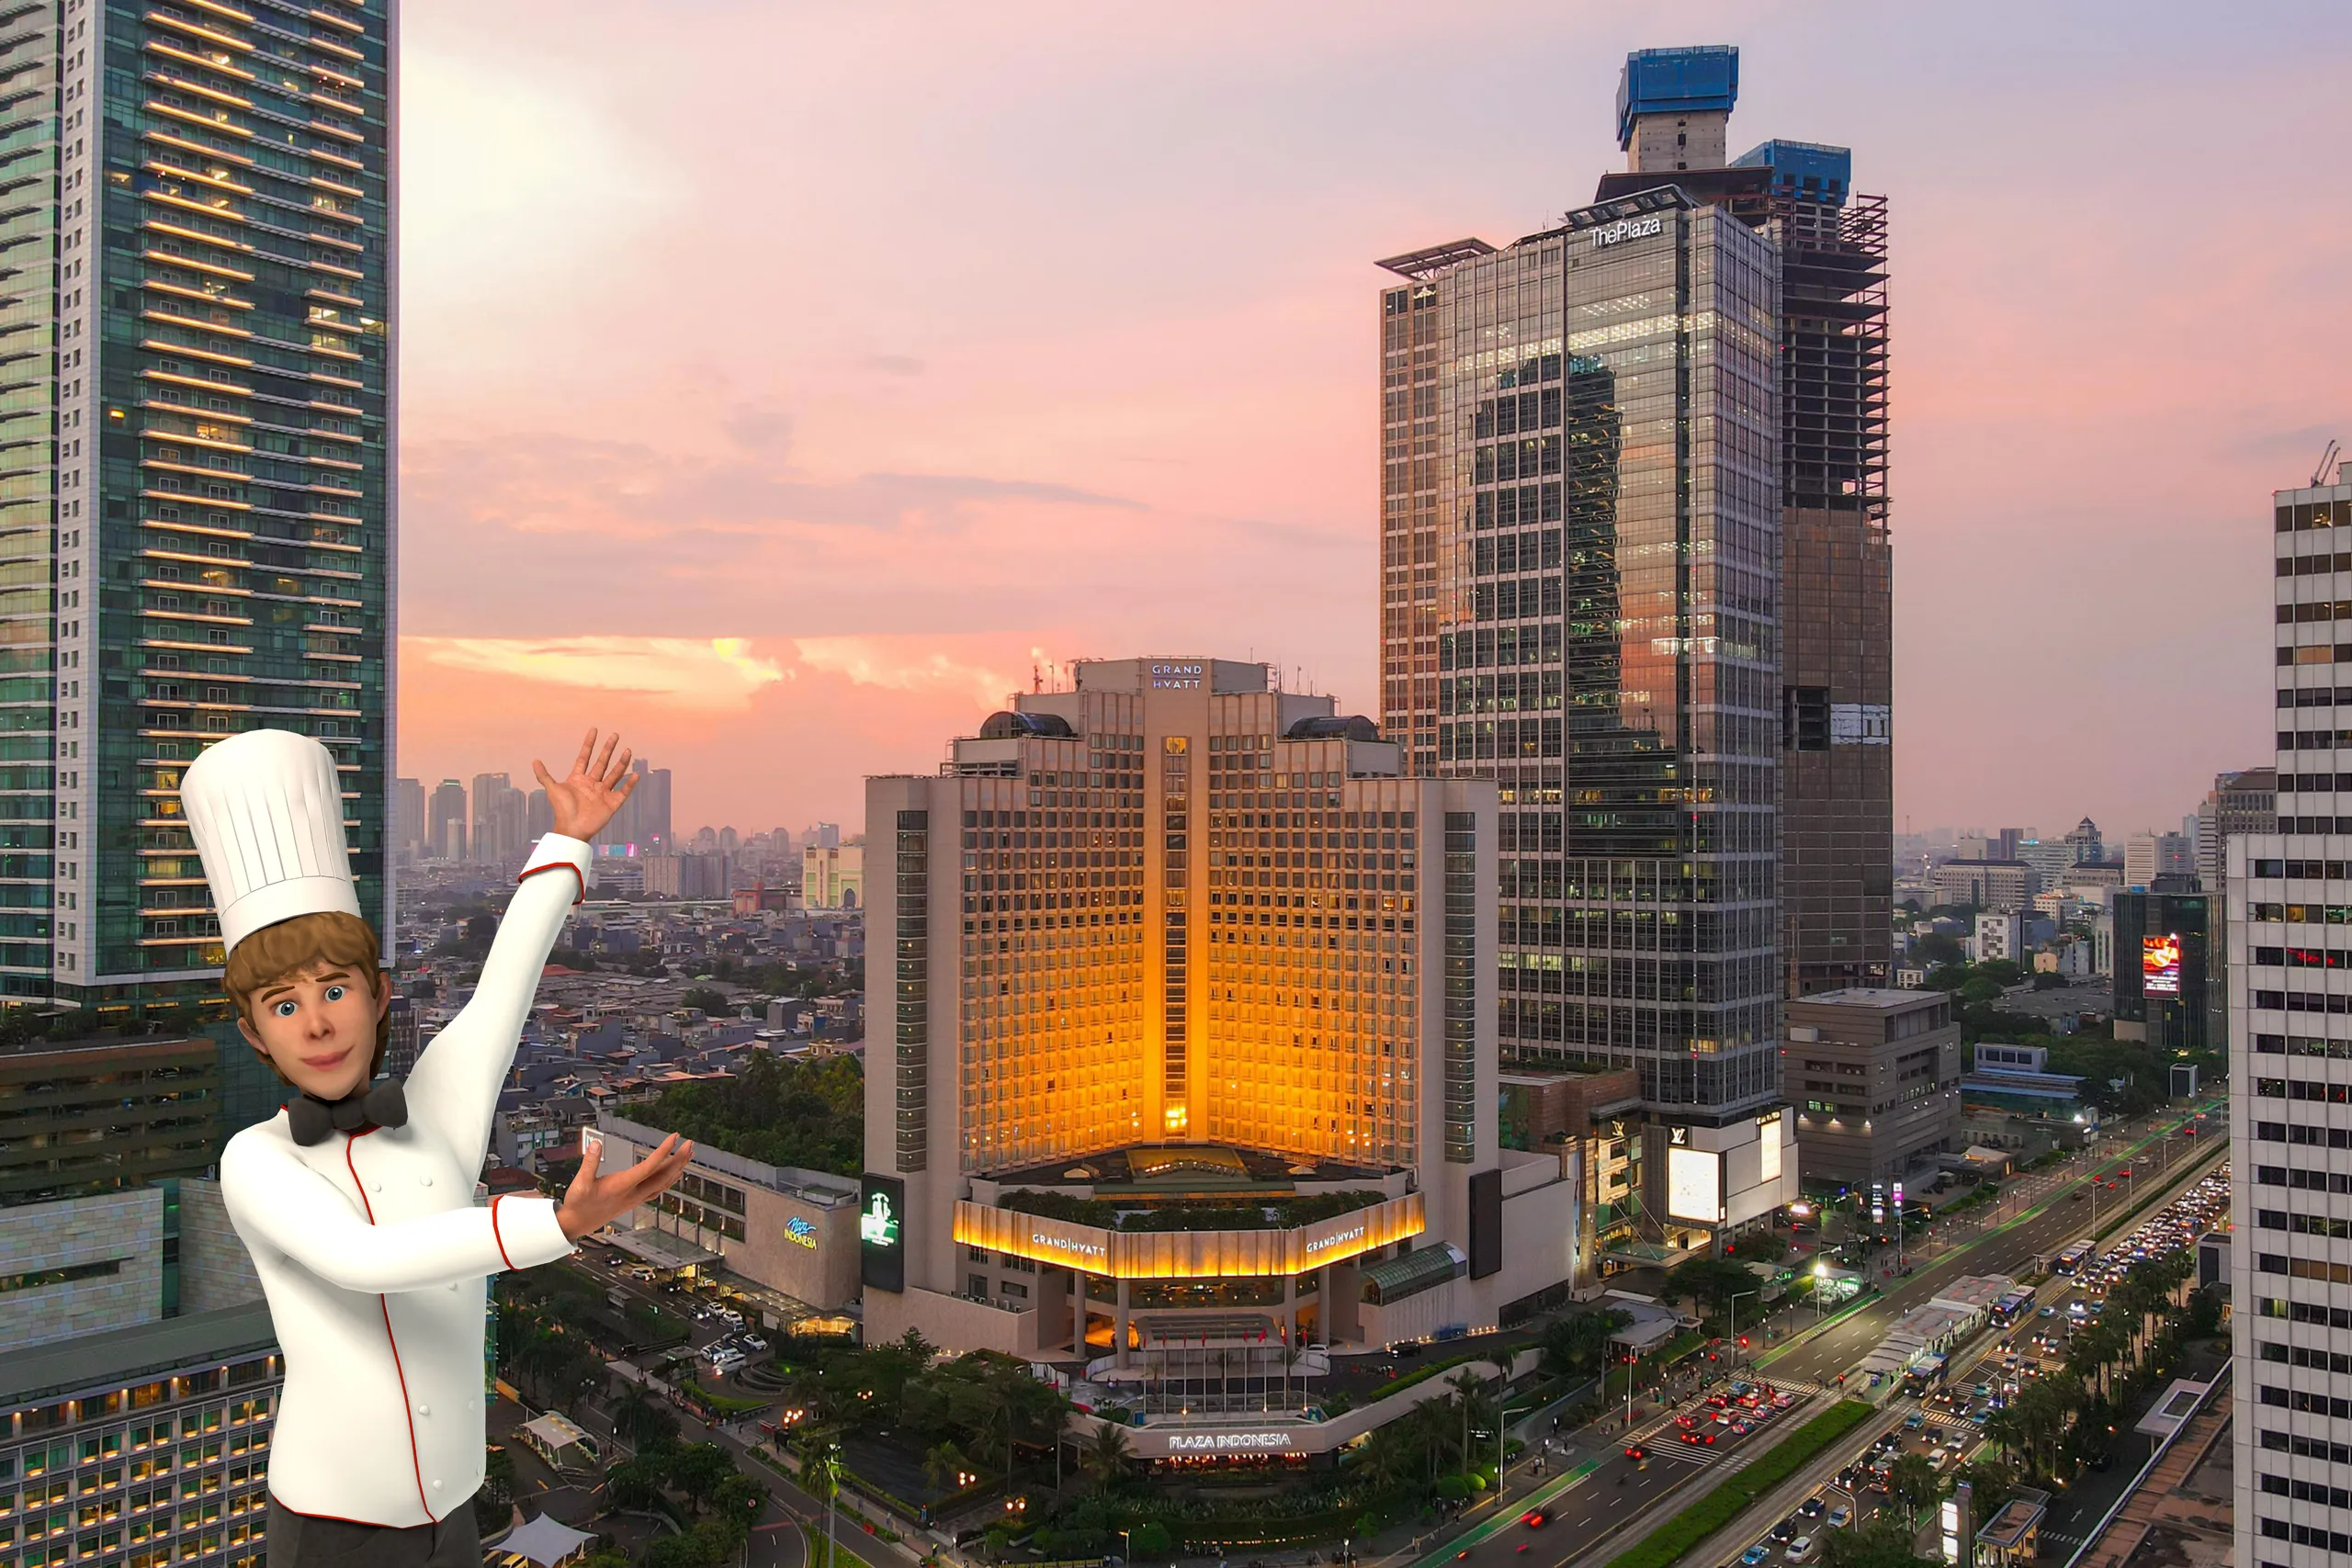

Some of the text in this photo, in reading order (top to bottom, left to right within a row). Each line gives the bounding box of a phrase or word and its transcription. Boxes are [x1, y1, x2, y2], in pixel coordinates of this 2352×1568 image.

[1152, 665, 1202, 674] GRAND
[1153, 681, 1201, 689] HYATT
[1169, 1433, 1292, 1450] PLAZA INDONESIA
